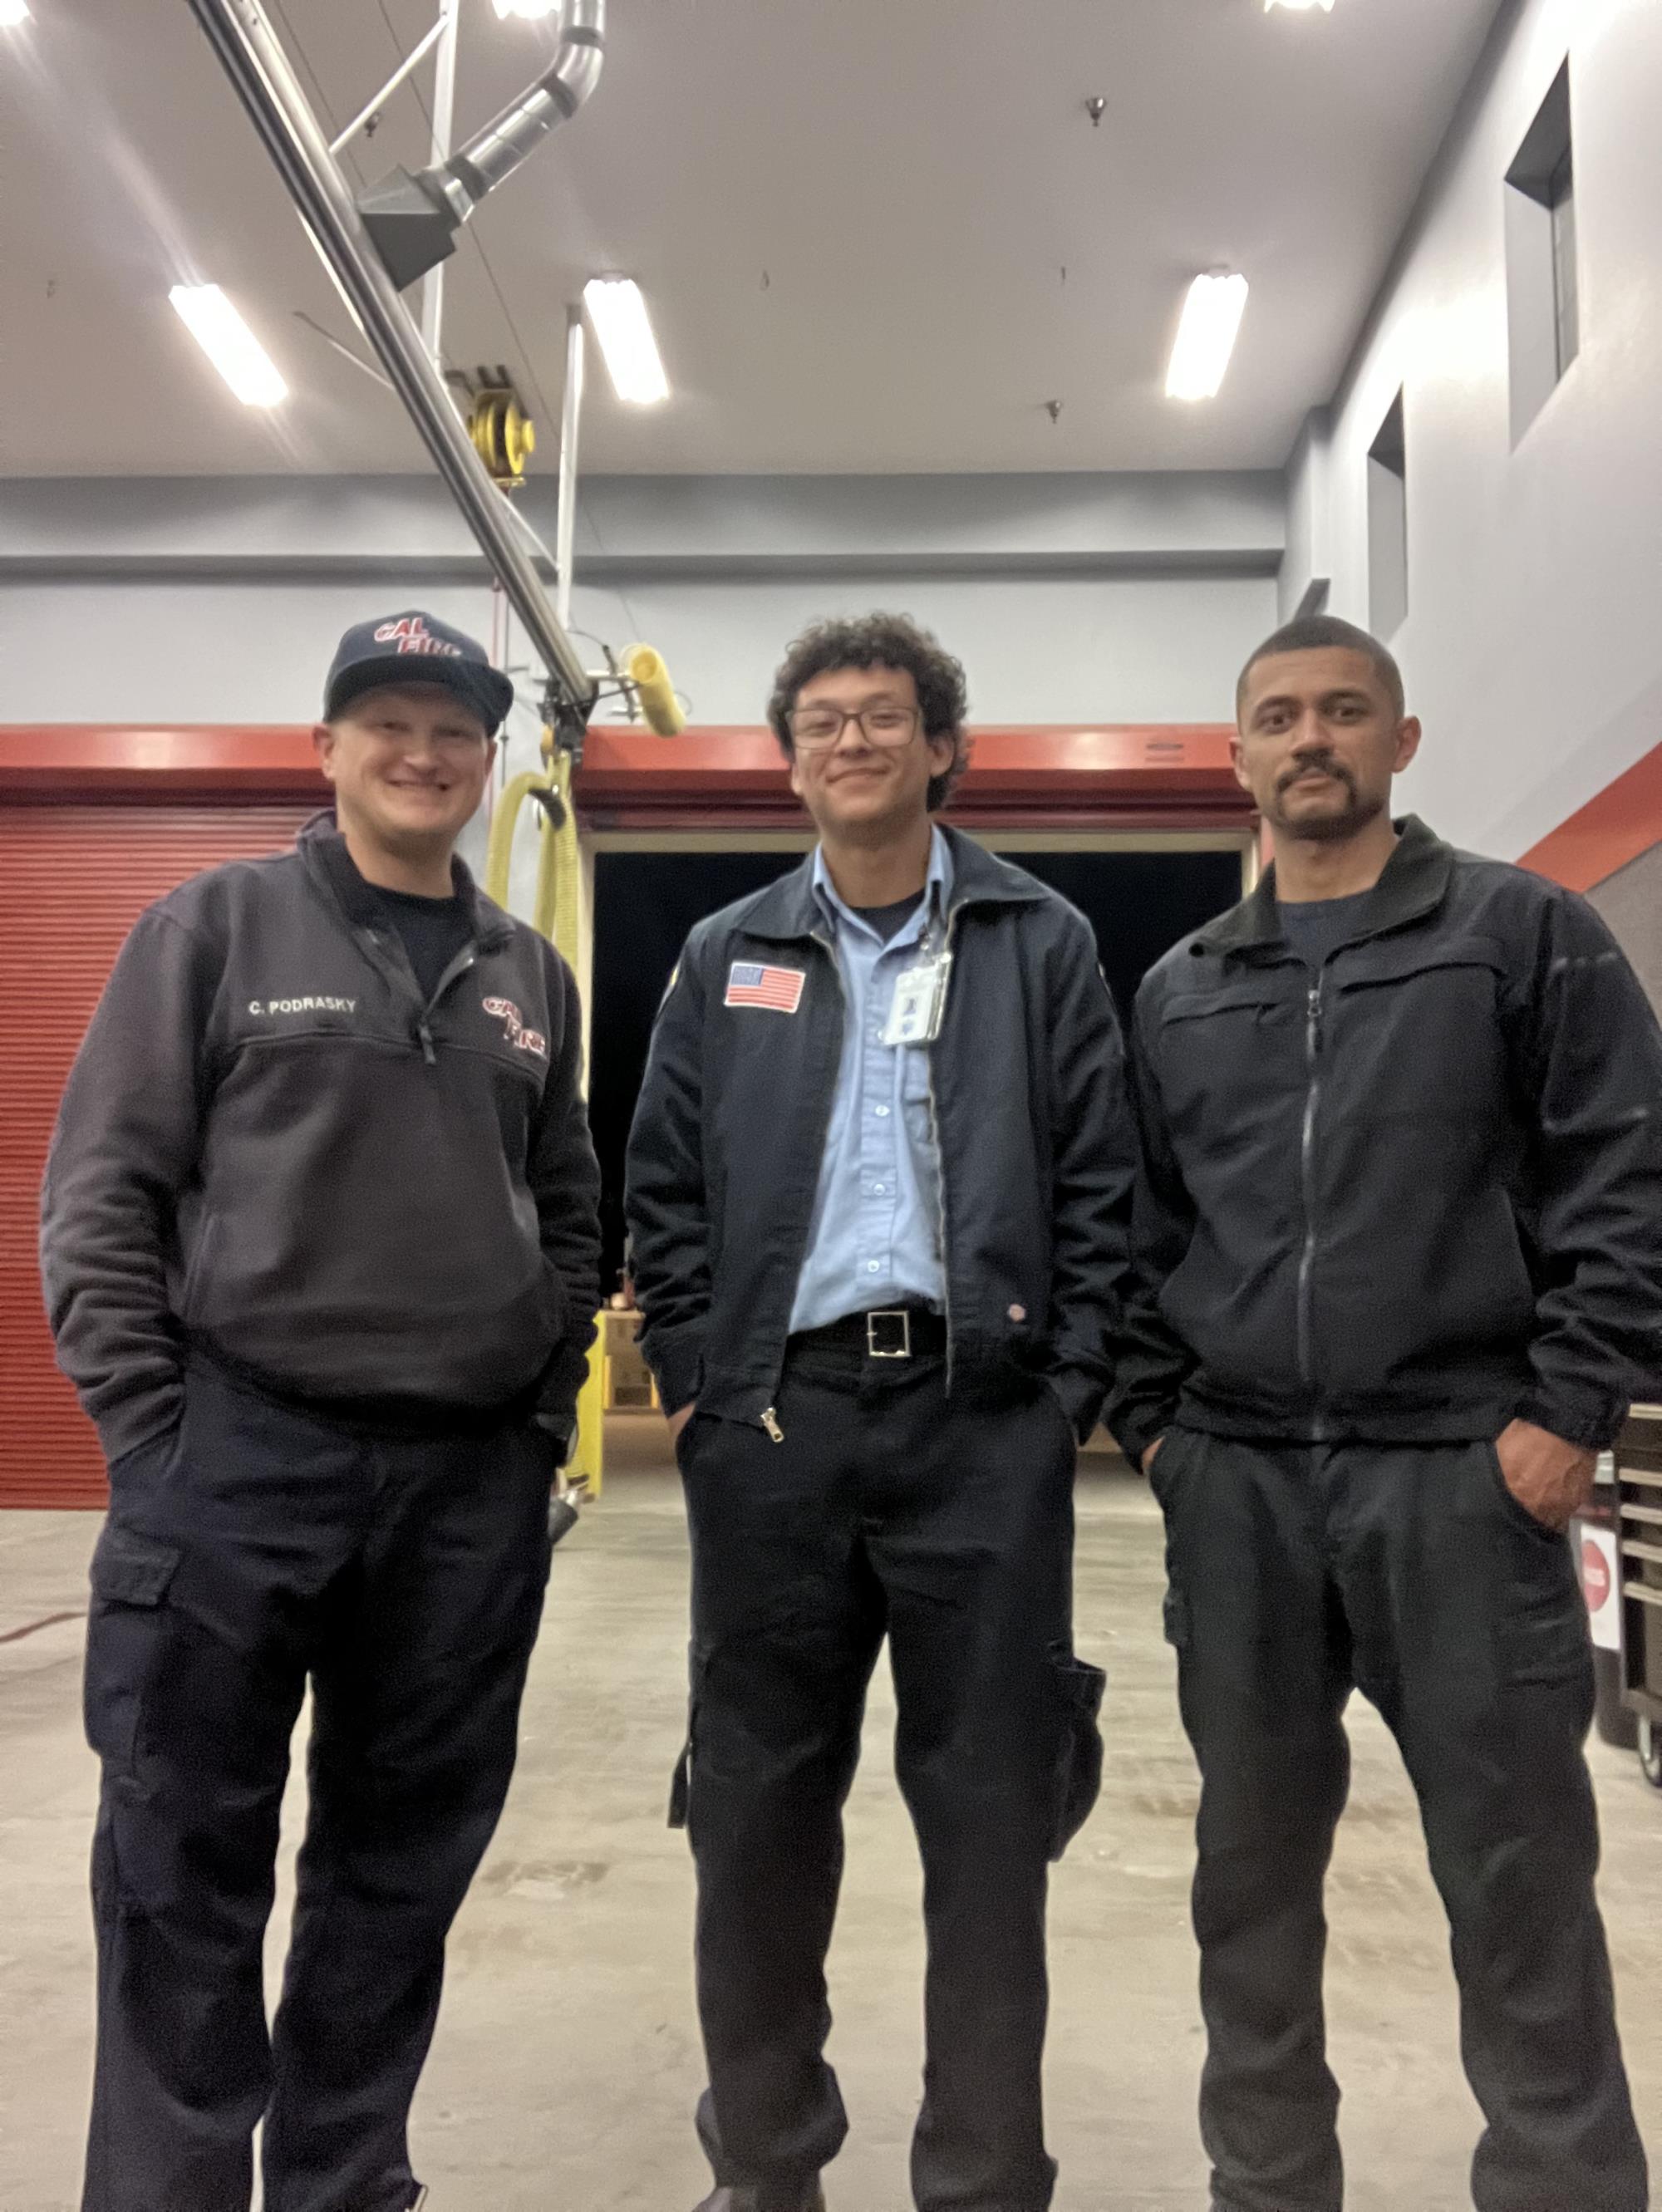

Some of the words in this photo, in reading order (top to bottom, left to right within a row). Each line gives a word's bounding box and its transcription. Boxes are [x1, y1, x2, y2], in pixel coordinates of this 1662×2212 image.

[374, 617, 429, 641] CAL
[248, 1000, 265, 1015] C.
[268, 997, 356, 1015] PODRASKY
